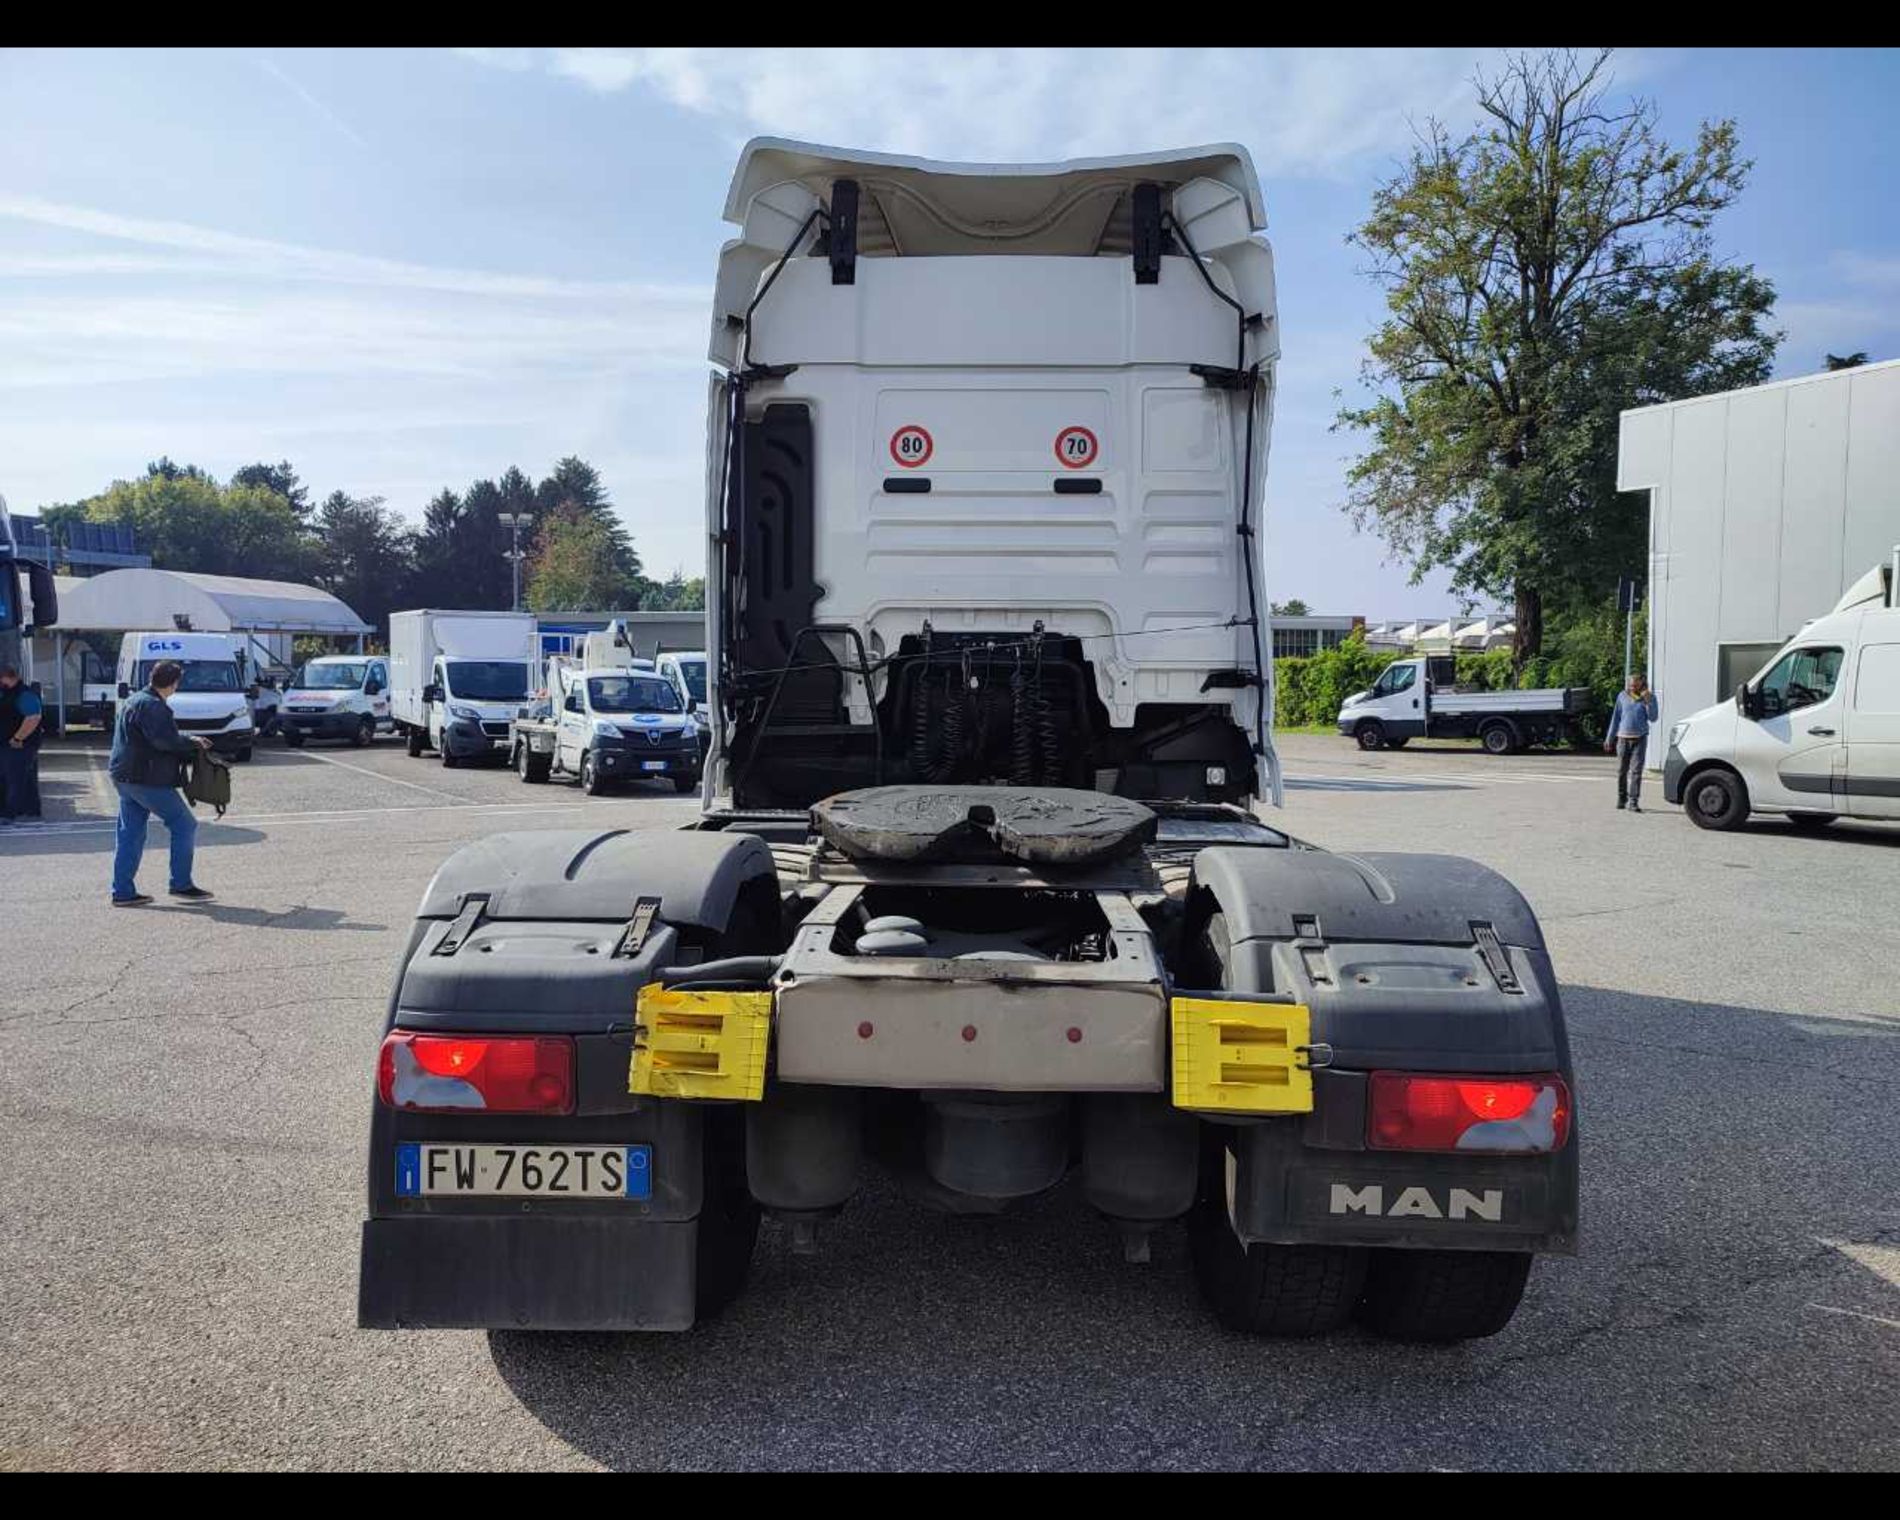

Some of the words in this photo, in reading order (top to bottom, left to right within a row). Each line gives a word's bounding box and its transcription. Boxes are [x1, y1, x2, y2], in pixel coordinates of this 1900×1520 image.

[902, 437, 922, 453] 80
[1067, 438, 1087, 454] 70
[148, 641, 182, 651] GLS
[428, 1149, 476, 1190] FW
[495, 1150, 623, 1191] 762TS
[1329, 1184, 1503, 1221] MAN
